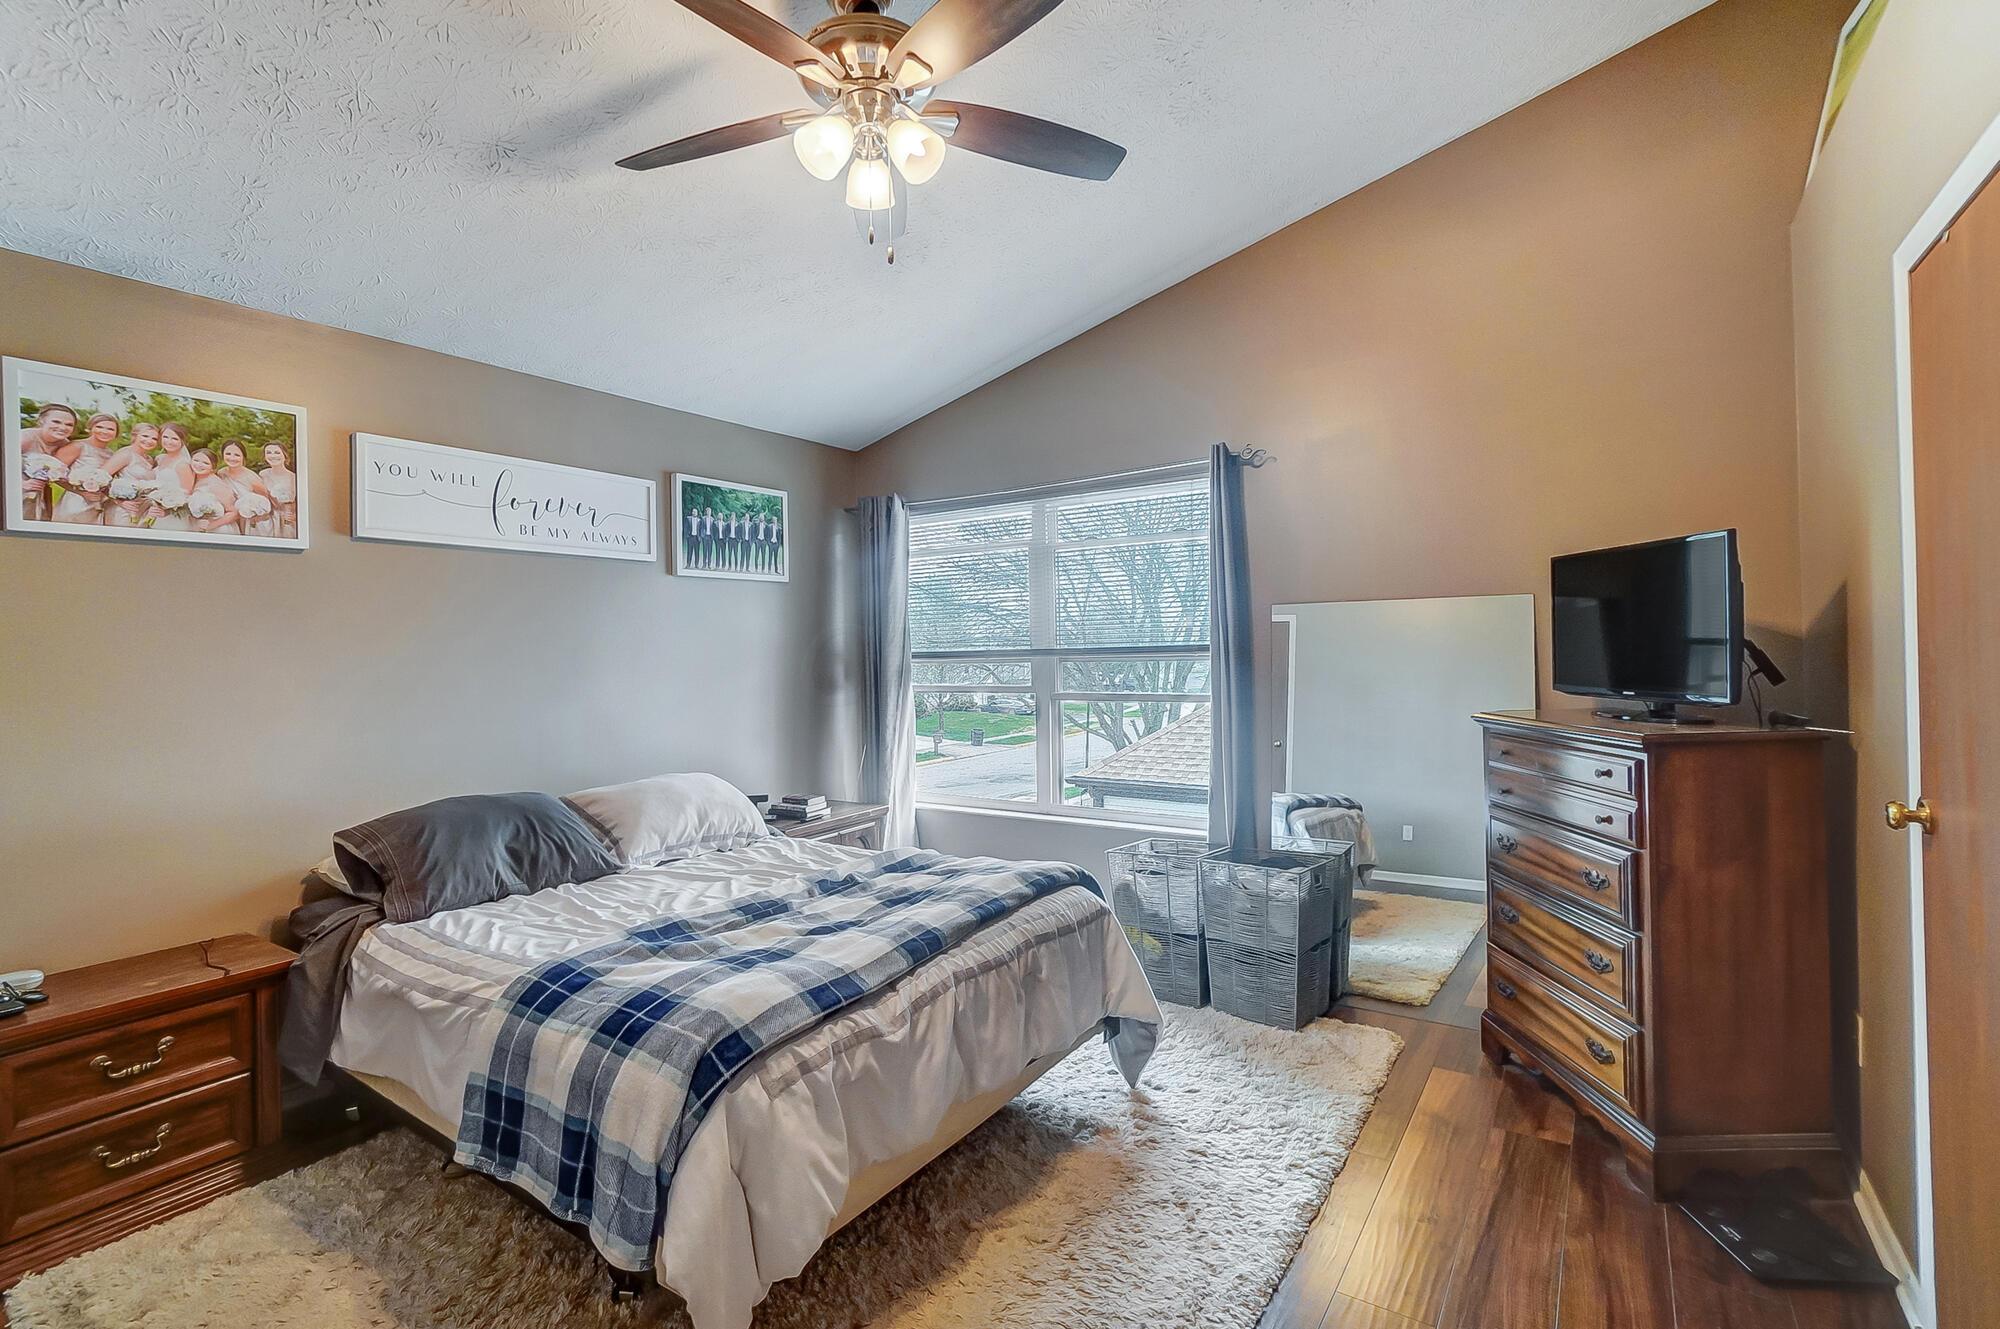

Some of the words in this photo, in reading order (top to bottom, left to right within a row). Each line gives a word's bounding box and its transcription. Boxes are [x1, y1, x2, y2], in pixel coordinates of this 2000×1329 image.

[374, 461, 418, 479] YOU
[430, 469, 481, 488] WILL
[492, 468, 606, 537] forever
[519, 523, 538, 537] BE
[548, 527, 571, 540] MY
[580, 530, 638, 546] ALWAYS
